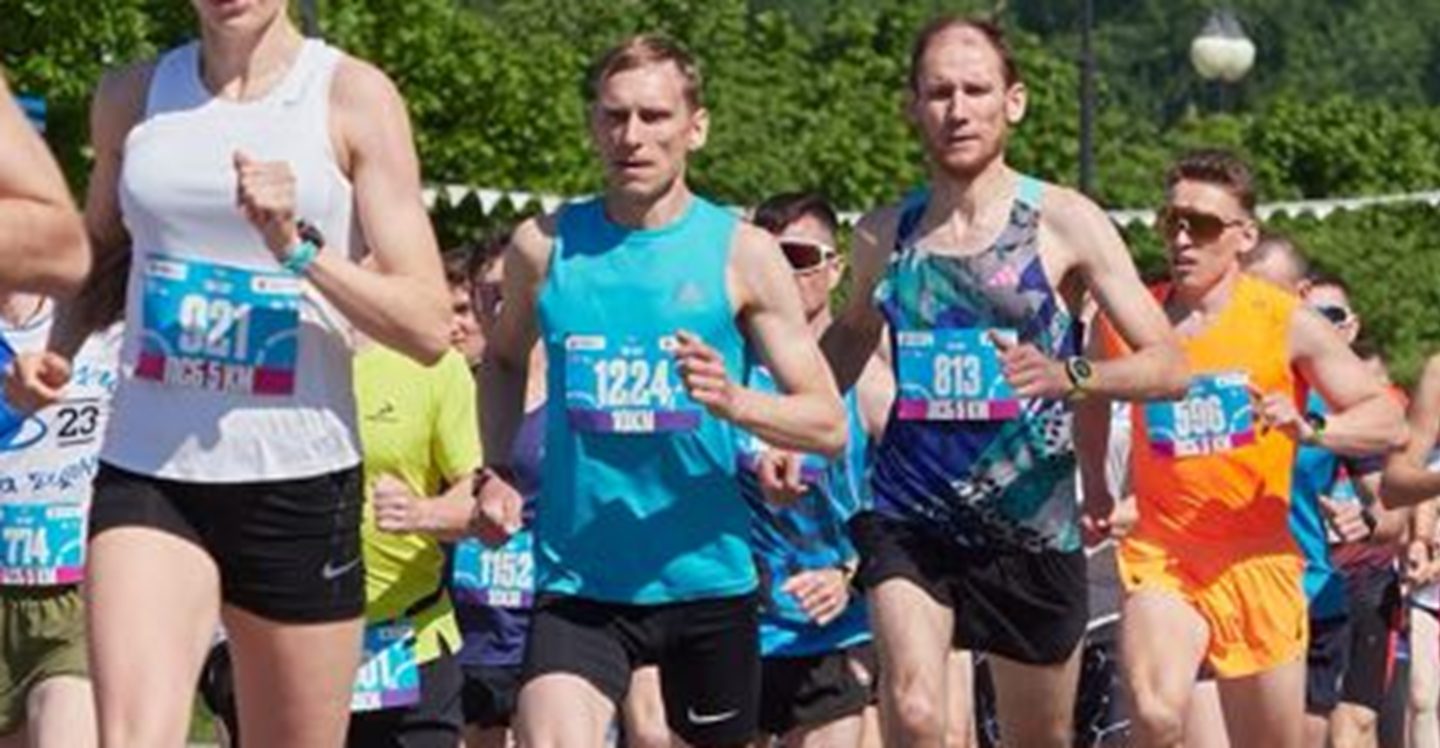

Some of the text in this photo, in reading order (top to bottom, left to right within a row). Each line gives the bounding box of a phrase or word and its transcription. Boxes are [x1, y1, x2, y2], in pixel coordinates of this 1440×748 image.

[179, 293, 252, 359] 921
[594, 358, 673, 406] 1224
[934, 353, 981, 397] 813
[57, 405, 99, 438] 23
[3, 525, 48, 567] 774
[481, 550, 534, 588] 1152
